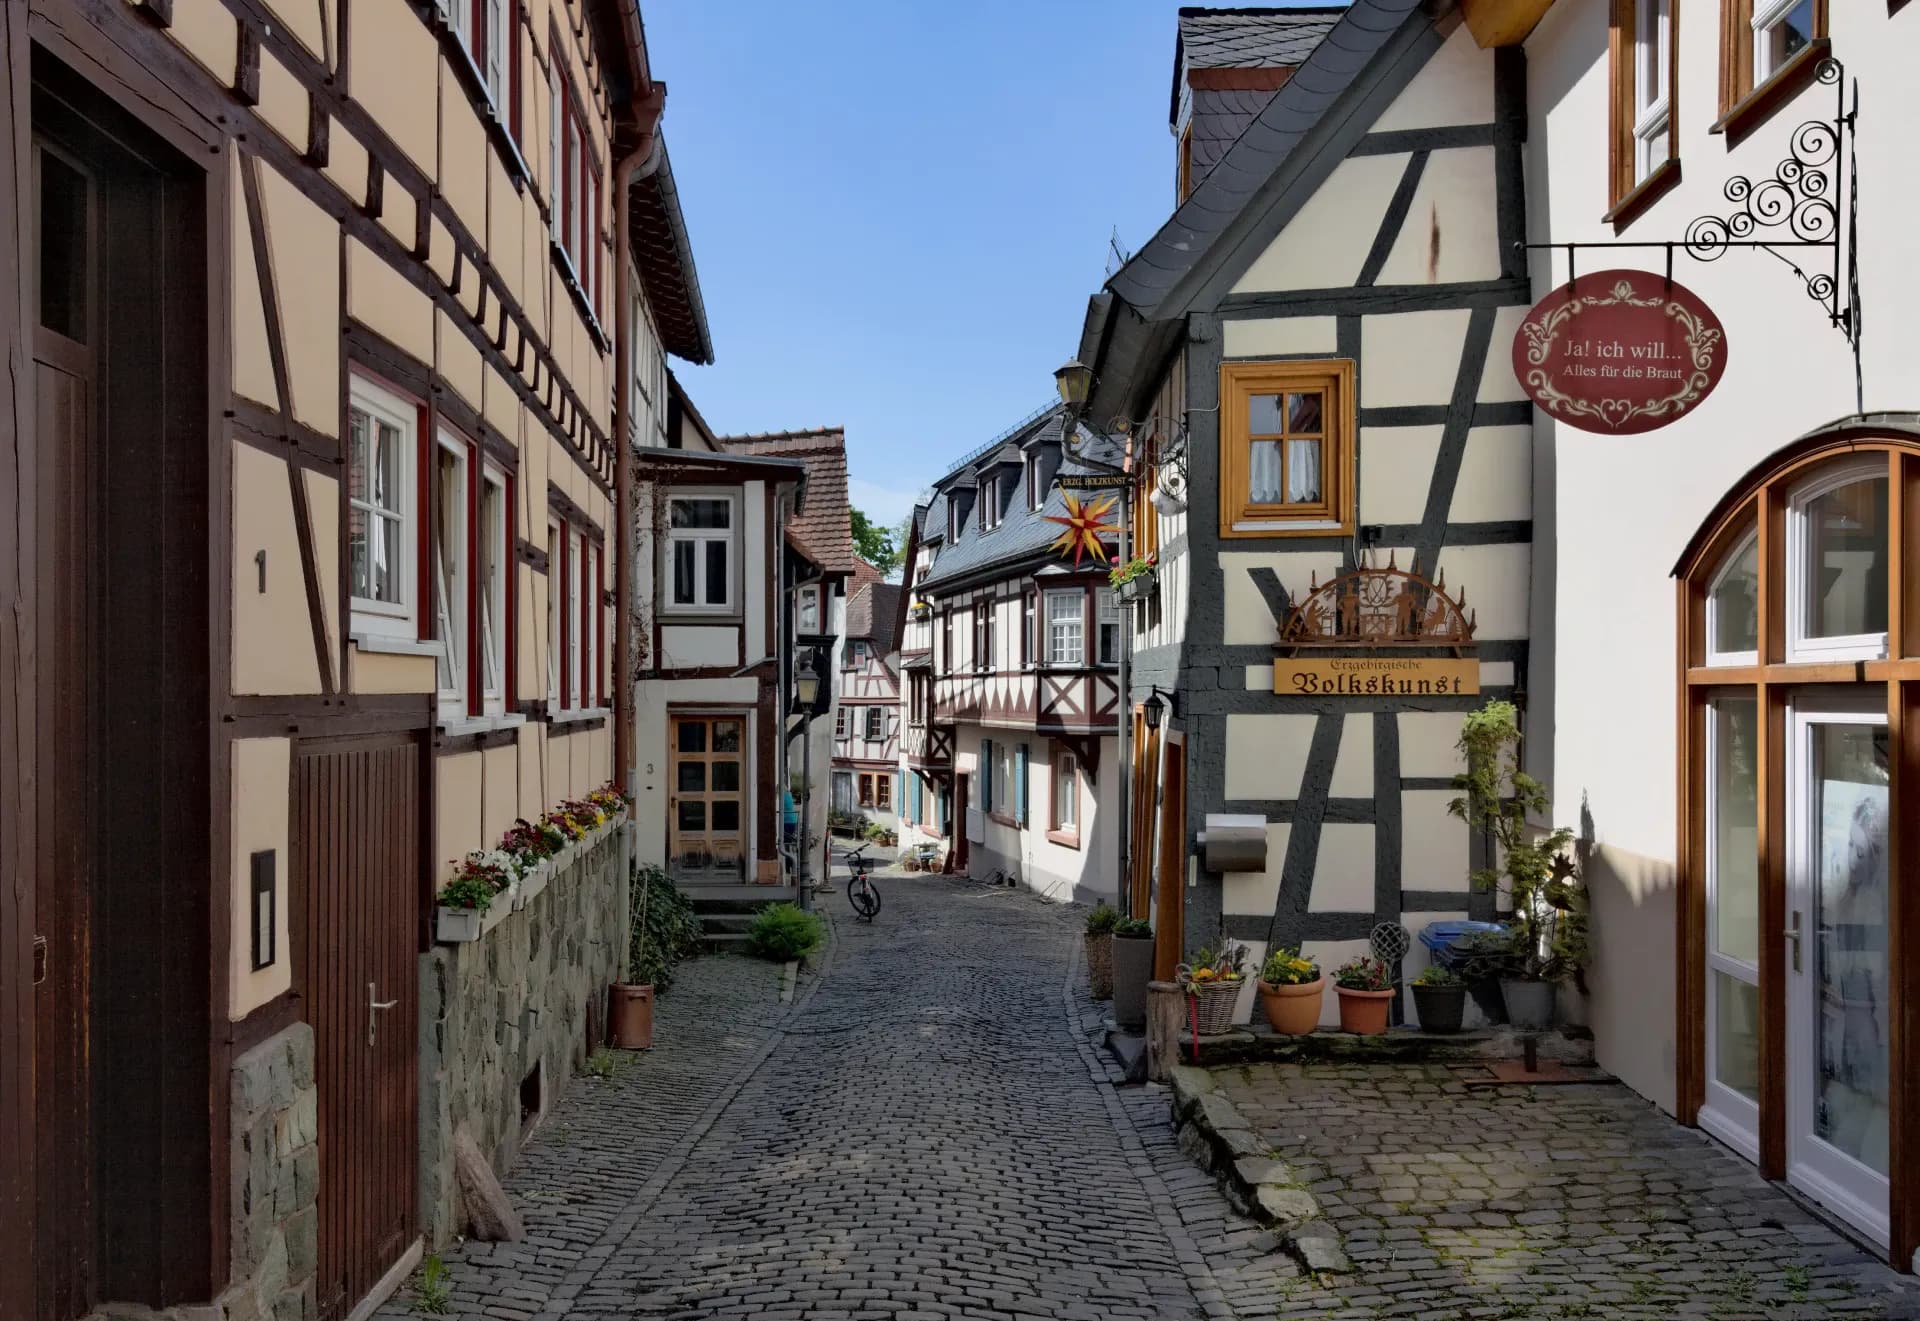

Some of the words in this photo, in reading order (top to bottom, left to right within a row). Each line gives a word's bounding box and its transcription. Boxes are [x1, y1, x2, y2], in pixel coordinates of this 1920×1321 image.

[1563, 340, 1590, 357] Ja!
[1597, 340, 1624, 358] ich
[1630, 341, 1682, 360] will...
[1562, 364, 1597, 377] Alles
[1600, 364, 1620, 377] für
[1622, 365, 1643, 378] die
[1646, 366, 1683, 379] Braut
[1084, 476, 1126, 487] HOLZKUNST
[254, 549, 266, 594] 1
[1330, 658, 1423, 672] Erzgebirgische
[1292, 672, 1462, 694] Volkskunst
[646, 763, 655, 775] 3
